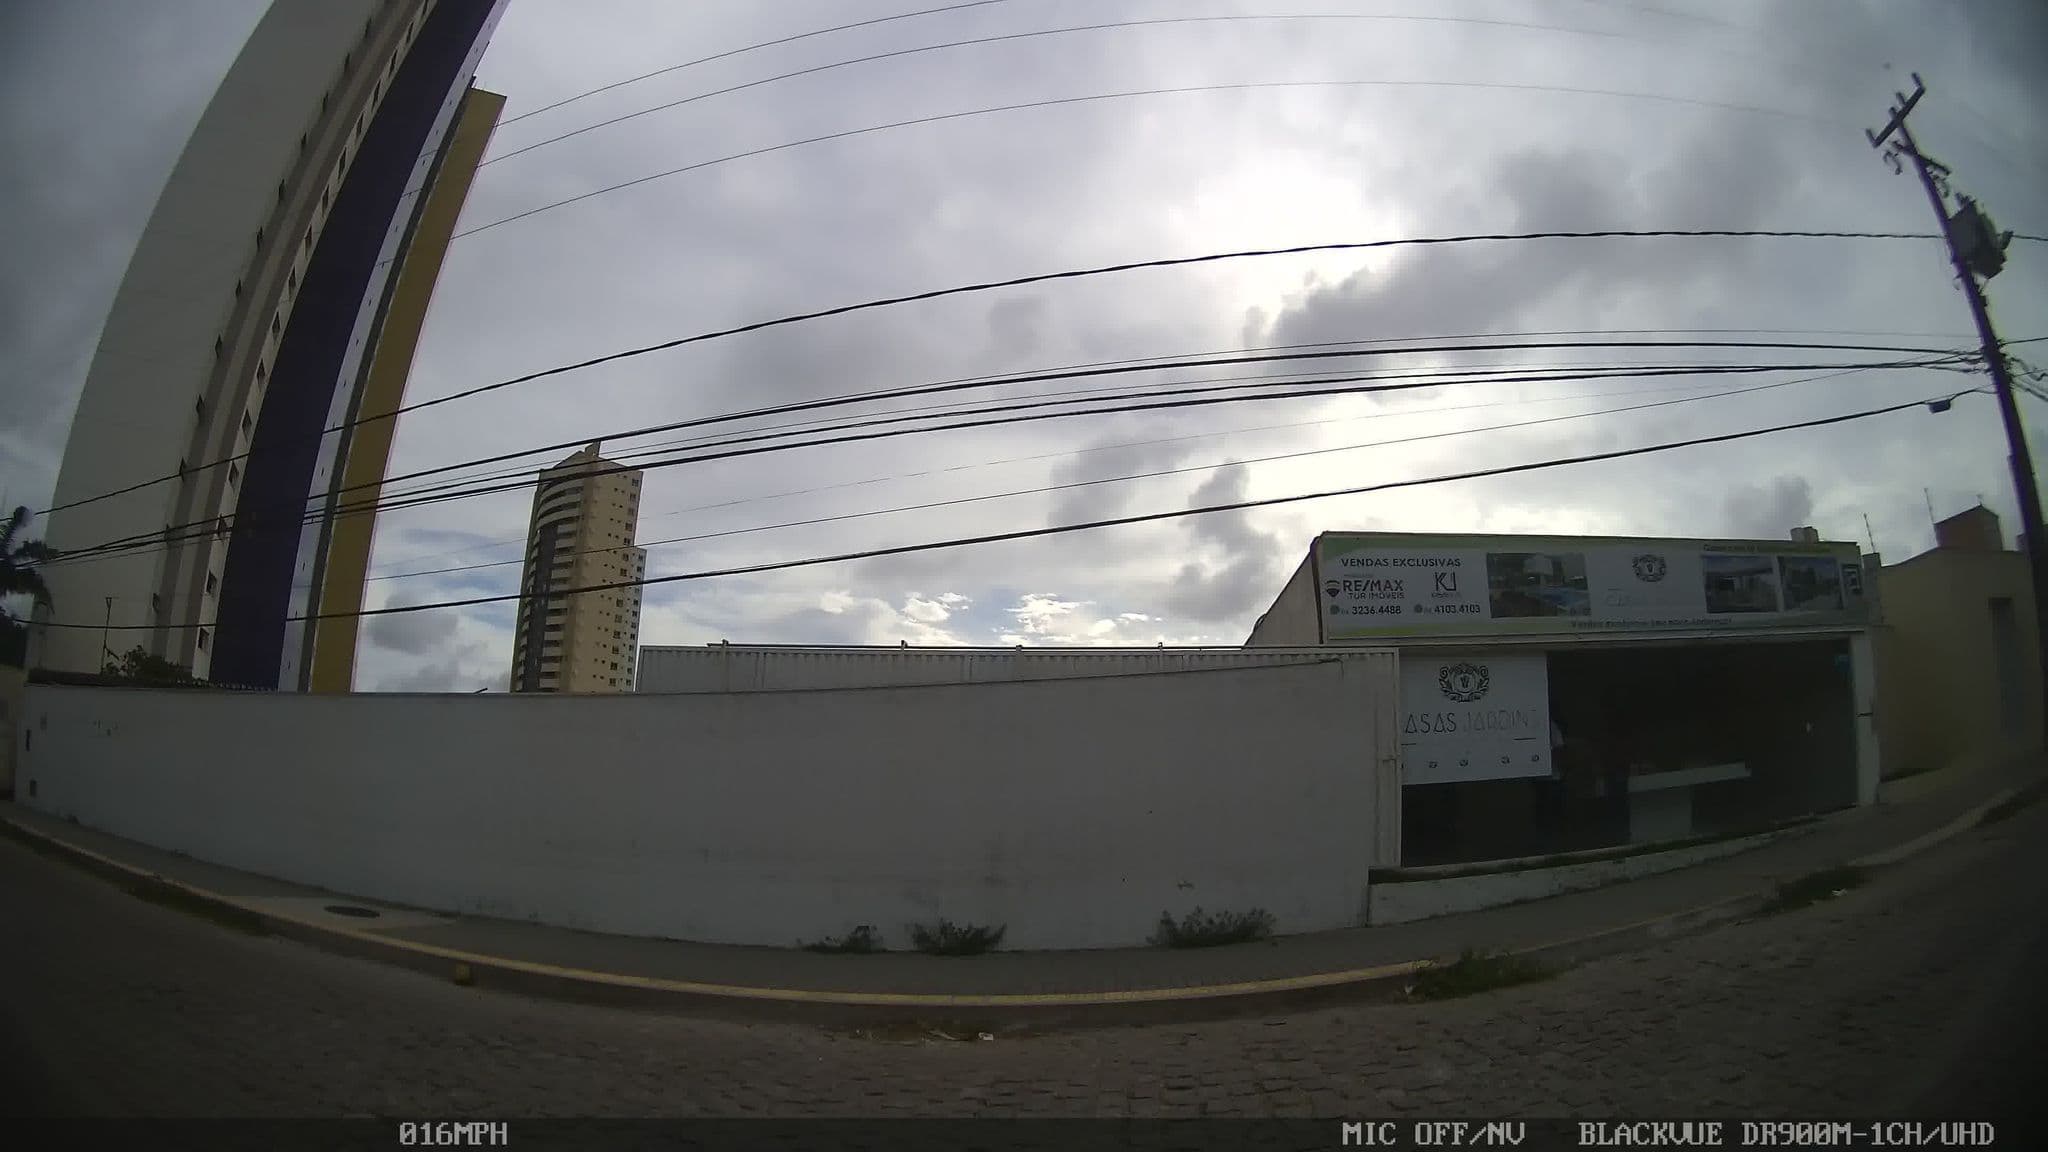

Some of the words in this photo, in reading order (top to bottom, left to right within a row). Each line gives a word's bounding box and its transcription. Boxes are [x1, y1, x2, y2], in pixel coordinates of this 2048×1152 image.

[1340, 558, 1389, 568] VENDAS
[1392, 558, 1462, 568] EXCLUSIVAS
[1343, 579, 1404, 592] RE/MAX
[1348, 592, 1366, 600] TUR
[1351, 605, 1402, 616] 3236.4488
[1434, 604, 1481, 615] 4103.4103
[1404, 711, 1457, 734] ASAS
[1463, 709, 1537, 732] JARDIN
